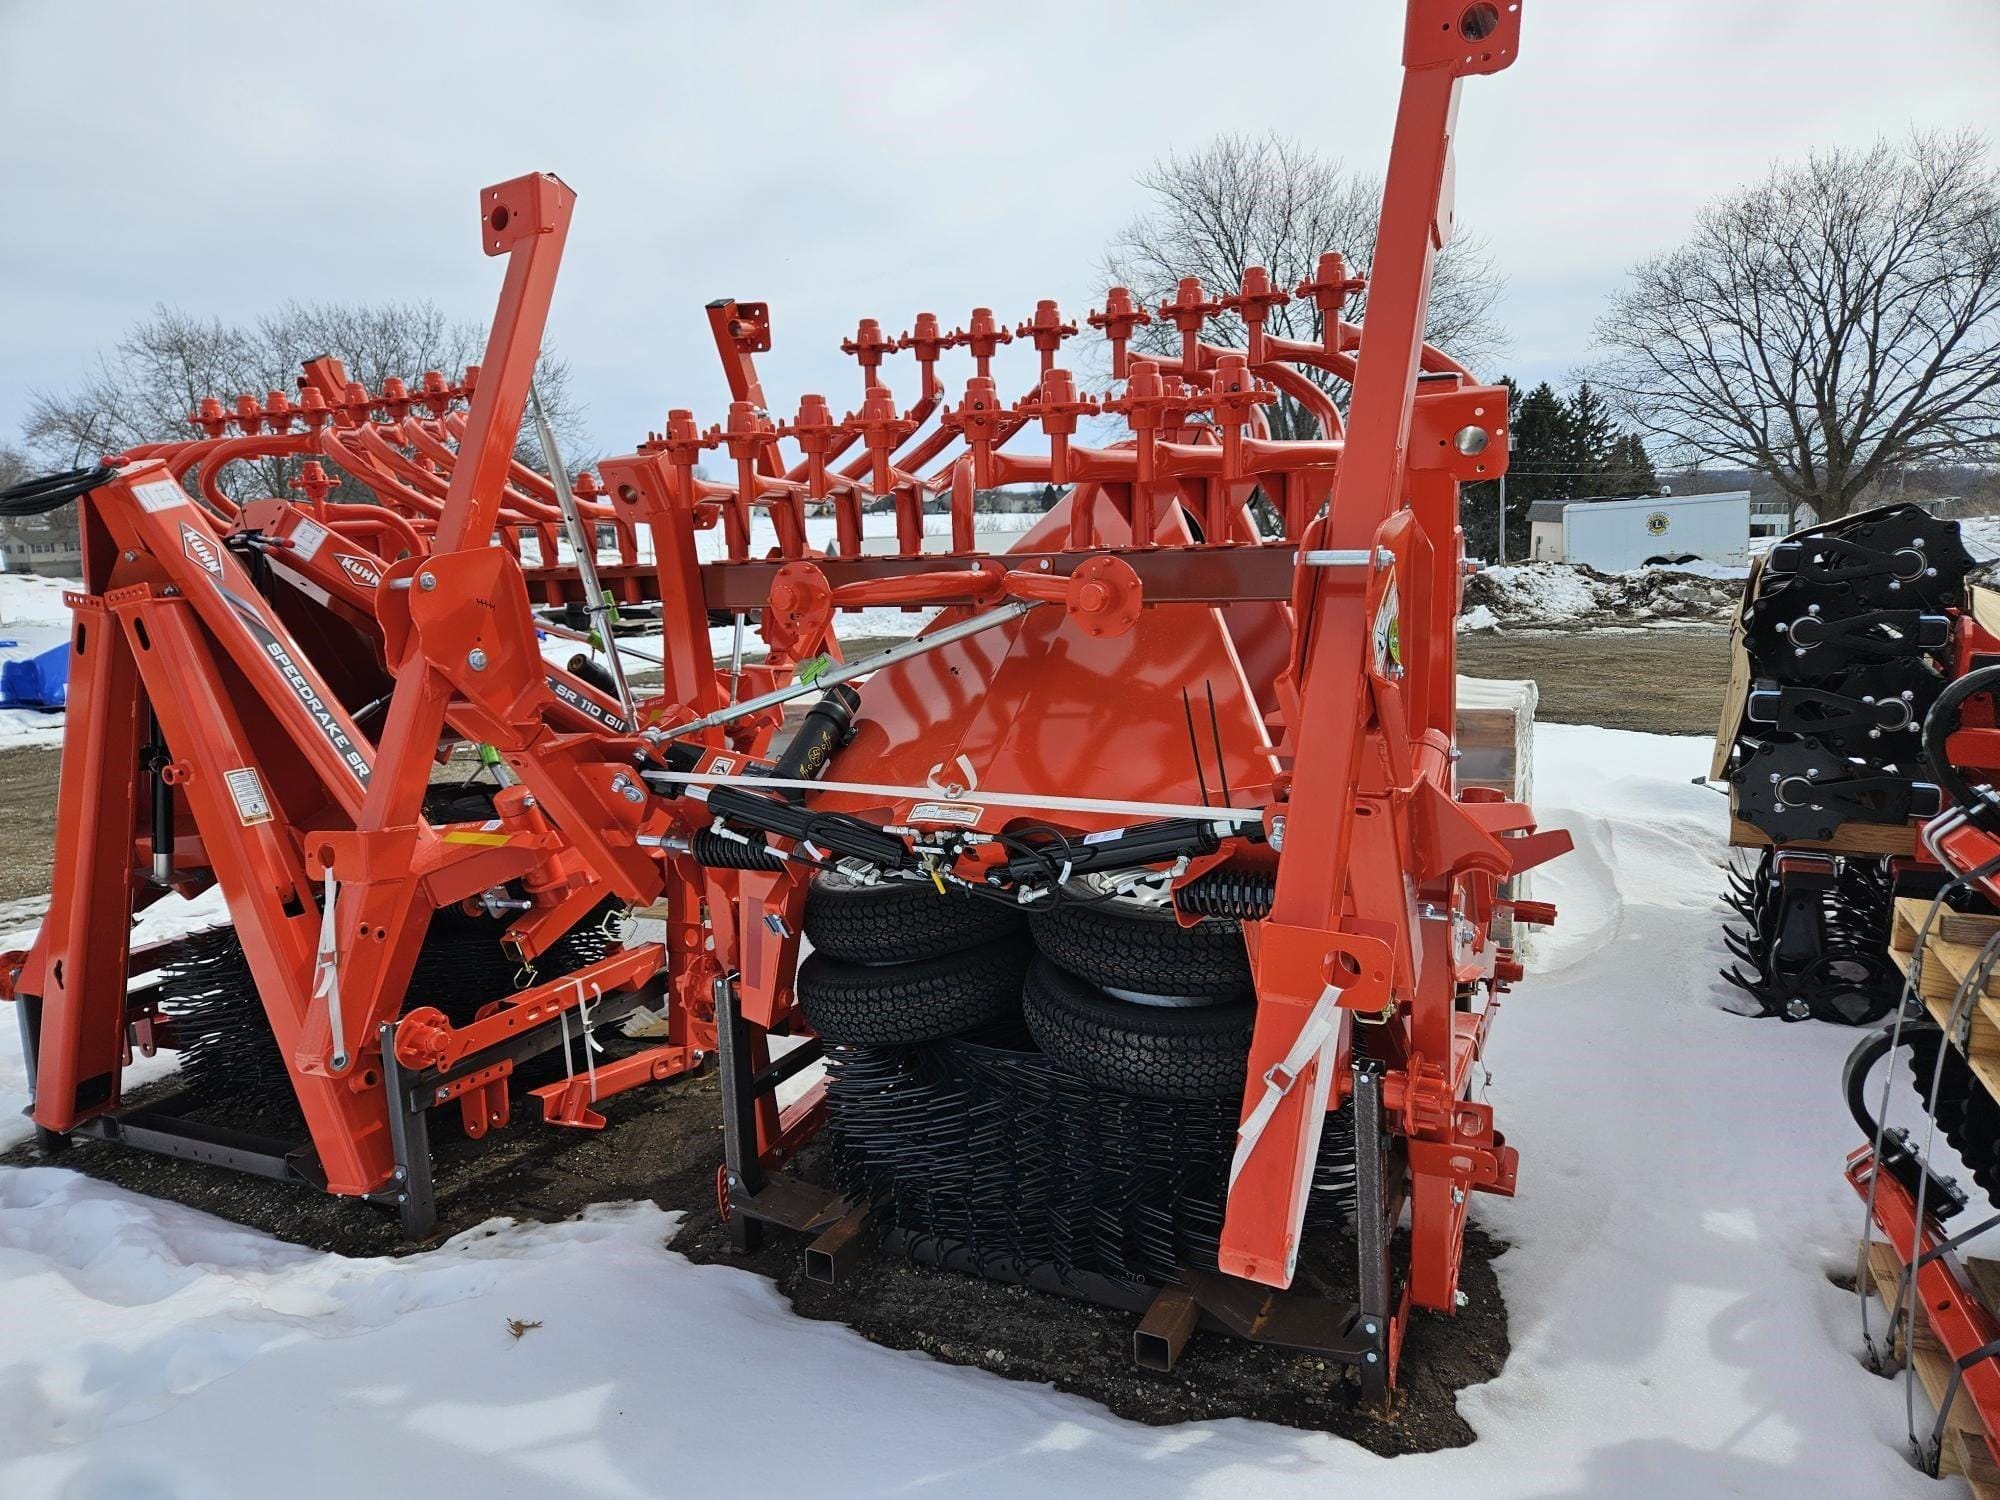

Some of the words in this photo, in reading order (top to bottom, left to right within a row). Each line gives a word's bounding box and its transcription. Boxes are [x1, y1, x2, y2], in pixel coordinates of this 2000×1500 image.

[183, 531, 221, 573] KUHN
[341, 557, 380, 586] KUHN
[266, 642, 351, 749] SPEEDRAKE
[346, 751, 371, 778] SR
[555, 684, 578, 703] SR
[581, 698, 602, 718] 110
[604, 713, 625, 731] GII
